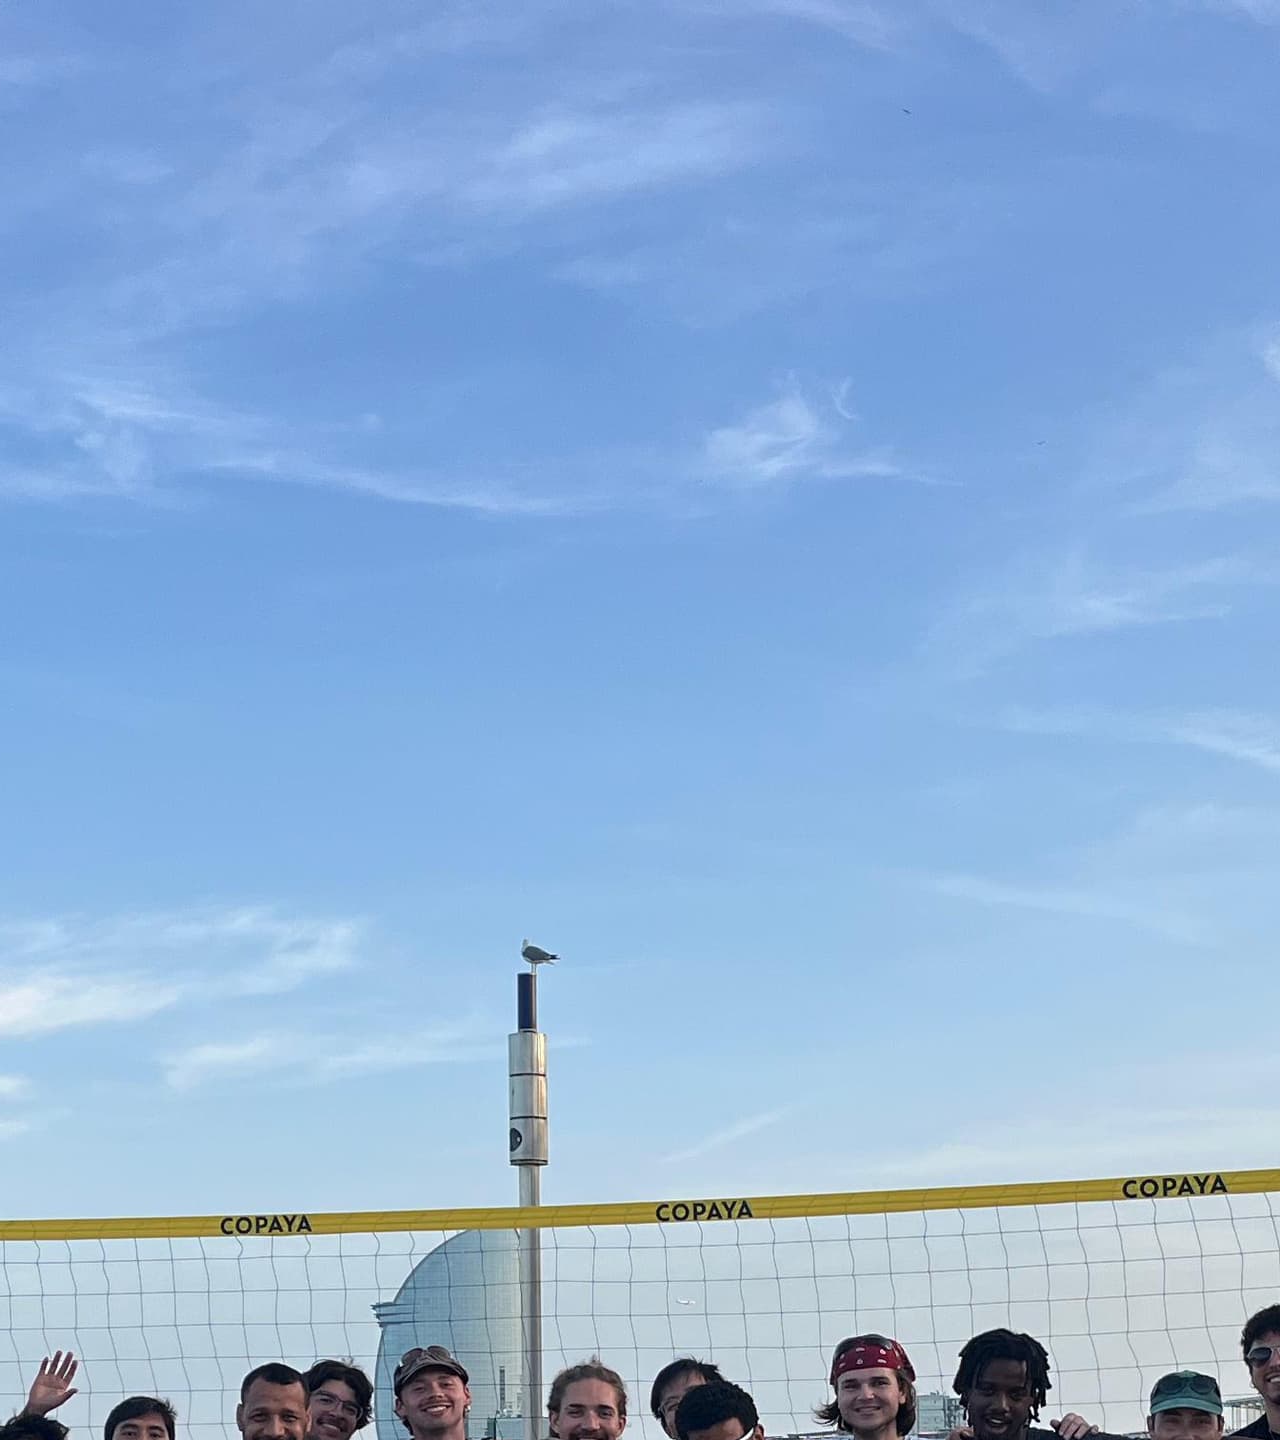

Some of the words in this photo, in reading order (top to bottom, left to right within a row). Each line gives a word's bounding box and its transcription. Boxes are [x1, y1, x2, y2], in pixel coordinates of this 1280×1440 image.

[1122, 1174, 1228, 1199] COPAYA
[655, 1199, 753, 1223] COPAYA
[220, 1214, 312, 1235] COPAYA
